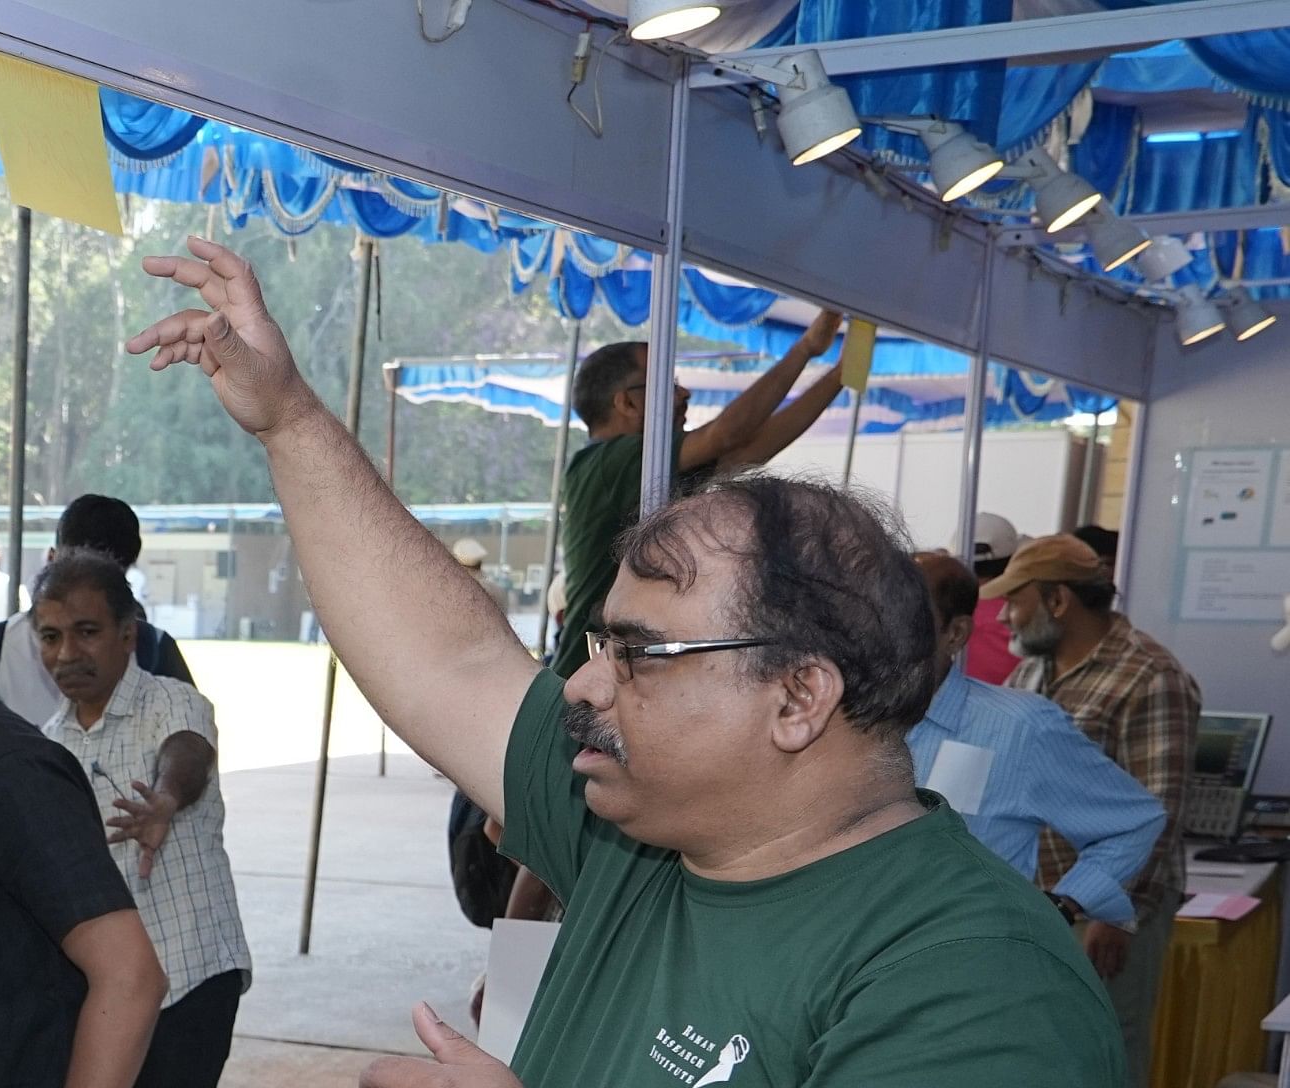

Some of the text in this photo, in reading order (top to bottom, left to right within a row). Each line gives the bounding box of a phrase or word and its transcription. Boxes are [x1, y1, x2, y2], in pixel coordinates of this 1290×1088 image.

[656, 1028, 706, 1069] RESEARCH
[682, 1024, 716, 1053] RAMAN
[649, 1045, 694, 1085] INSTITUTE
